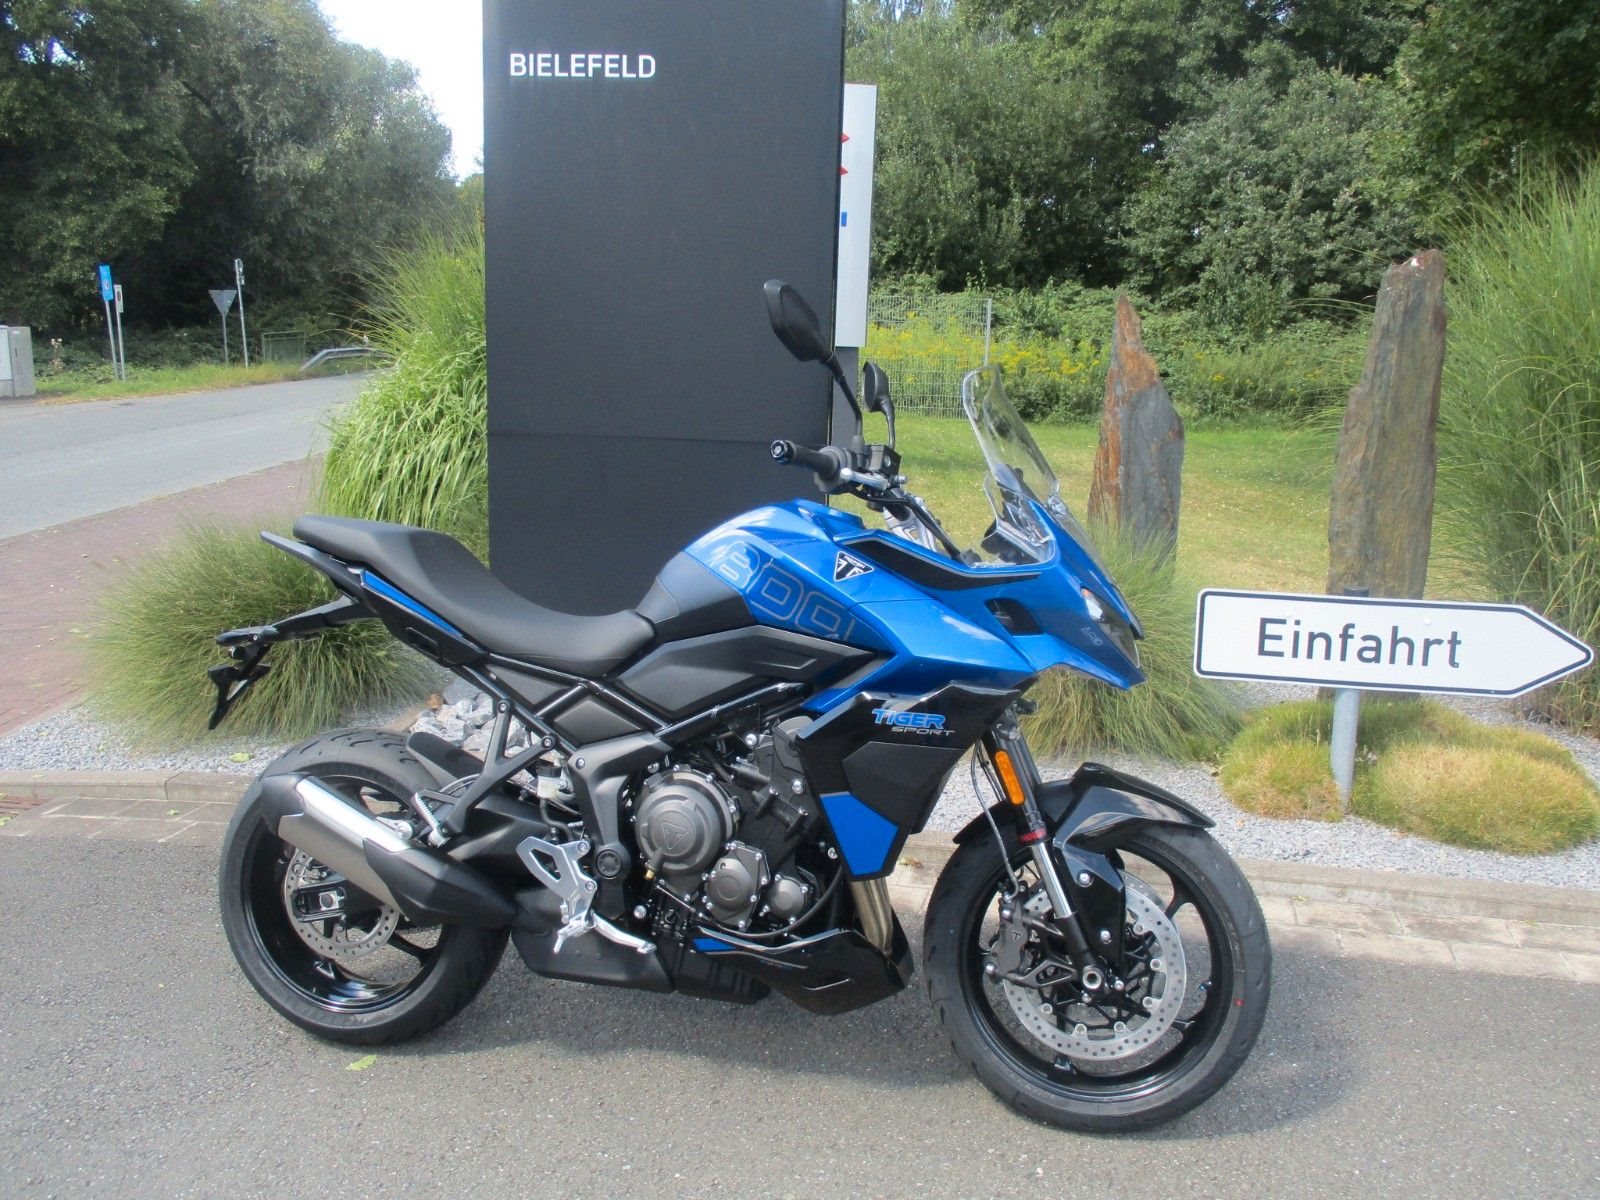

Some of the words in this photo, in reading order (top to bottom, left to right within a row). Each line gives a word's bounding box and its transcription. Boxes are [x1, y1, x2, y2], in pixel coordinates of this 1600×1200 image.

[509, 52, 656, 79] BIELEFELD
[1258, 617, 1462, 668] Einfahrt
[871, 708, 946, 730] TIGER
[890, 725, 956, 737] SPORT
